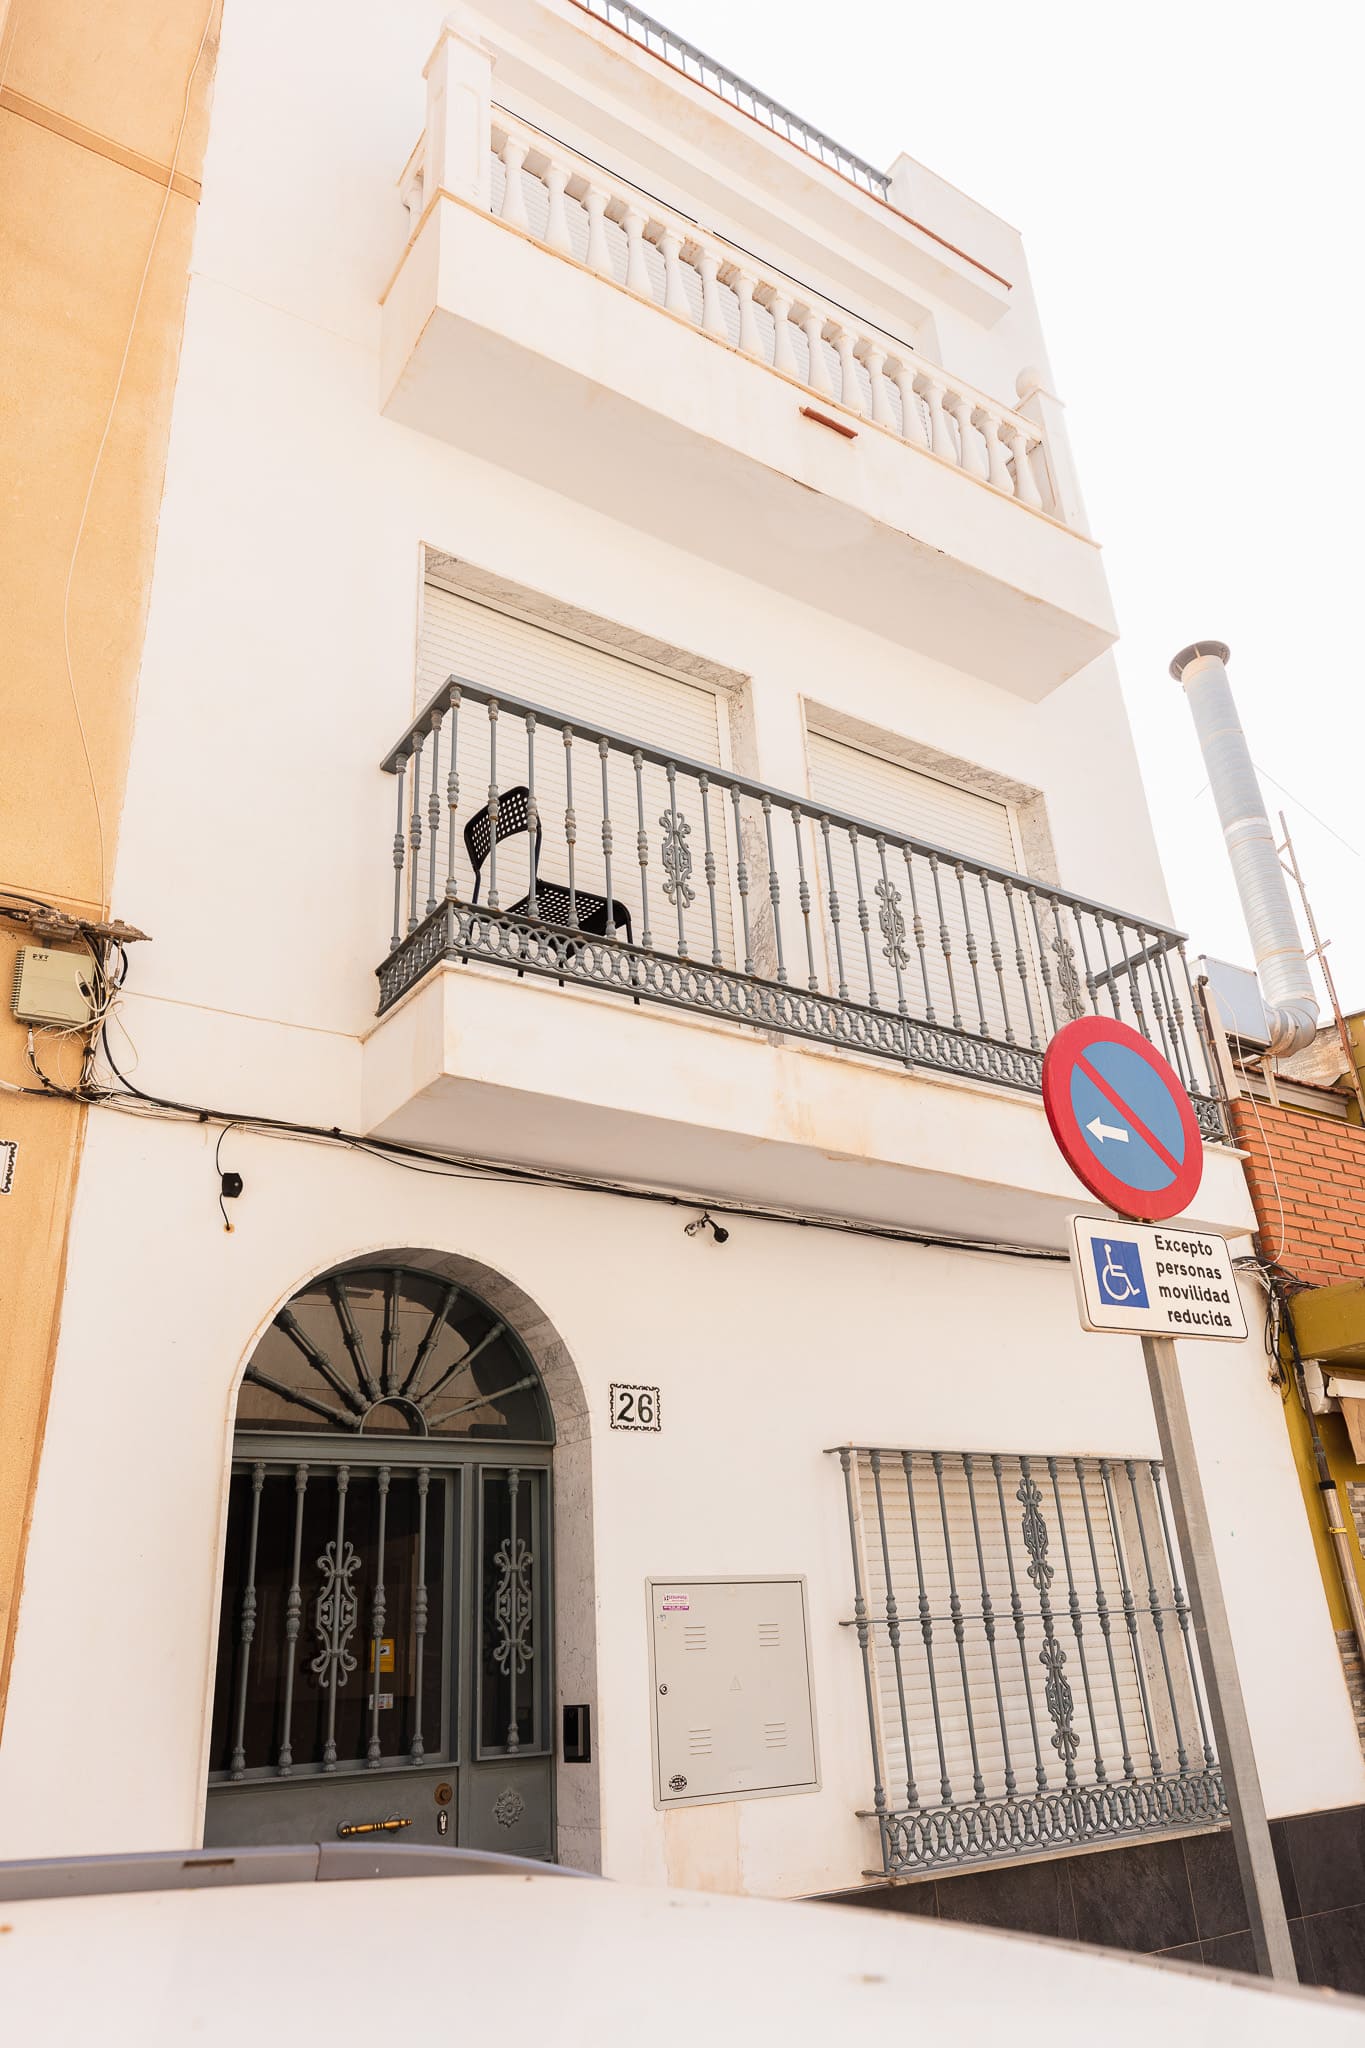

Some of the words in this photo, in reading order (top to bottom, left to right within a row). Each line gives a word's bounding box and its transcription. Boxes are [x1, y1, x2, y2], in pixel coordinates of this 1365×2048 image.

[1154, 1235, 1212, 1257] Excepto
[1156, 1261, 1222, 1279] personas
[1158, 1285, 1230, 1303] movilidad
[1167, 1309, 1232, 1327] reducida
[617, 1392, 653, 1423] 26
